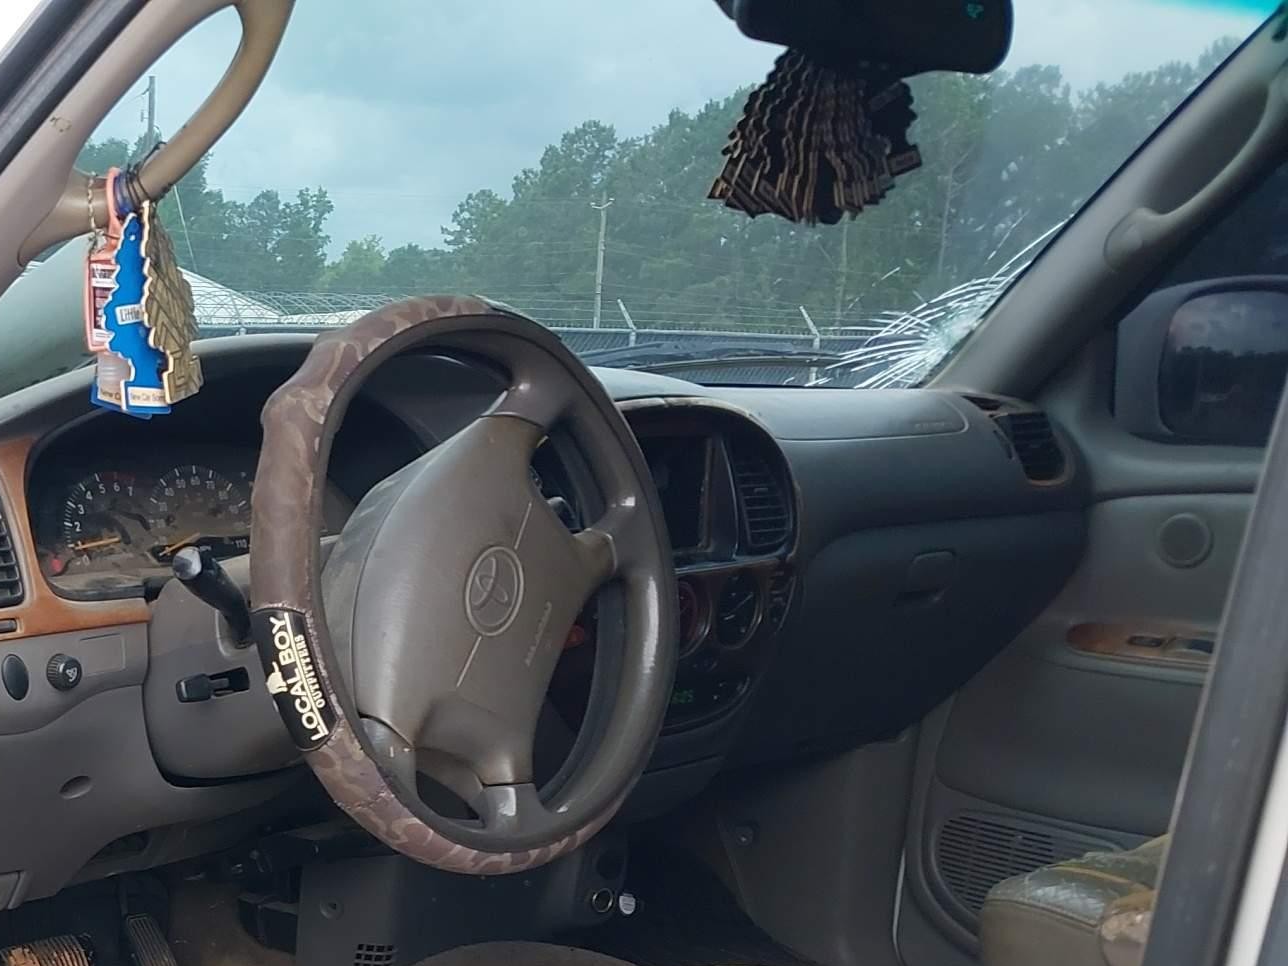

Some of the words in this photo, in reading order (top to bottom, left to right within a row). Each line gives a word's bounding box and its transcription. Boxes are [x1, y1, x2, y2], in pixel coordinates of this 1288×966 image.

[98, 483, 106, 494] 5
[113, 481, 121, 492] 6
[127, 486, 134, 497] 7
[85, 490, 93, 500] 4
[77, 503, 85, 515] 3
[73, 521, 82, 532] 2
[81, 554, 91, 566] 0
[269, 616, 297, 667] BOY
[294, 634, 326, 709] OUTFITTERS
[286, 667, 329, 741] LOCAL
